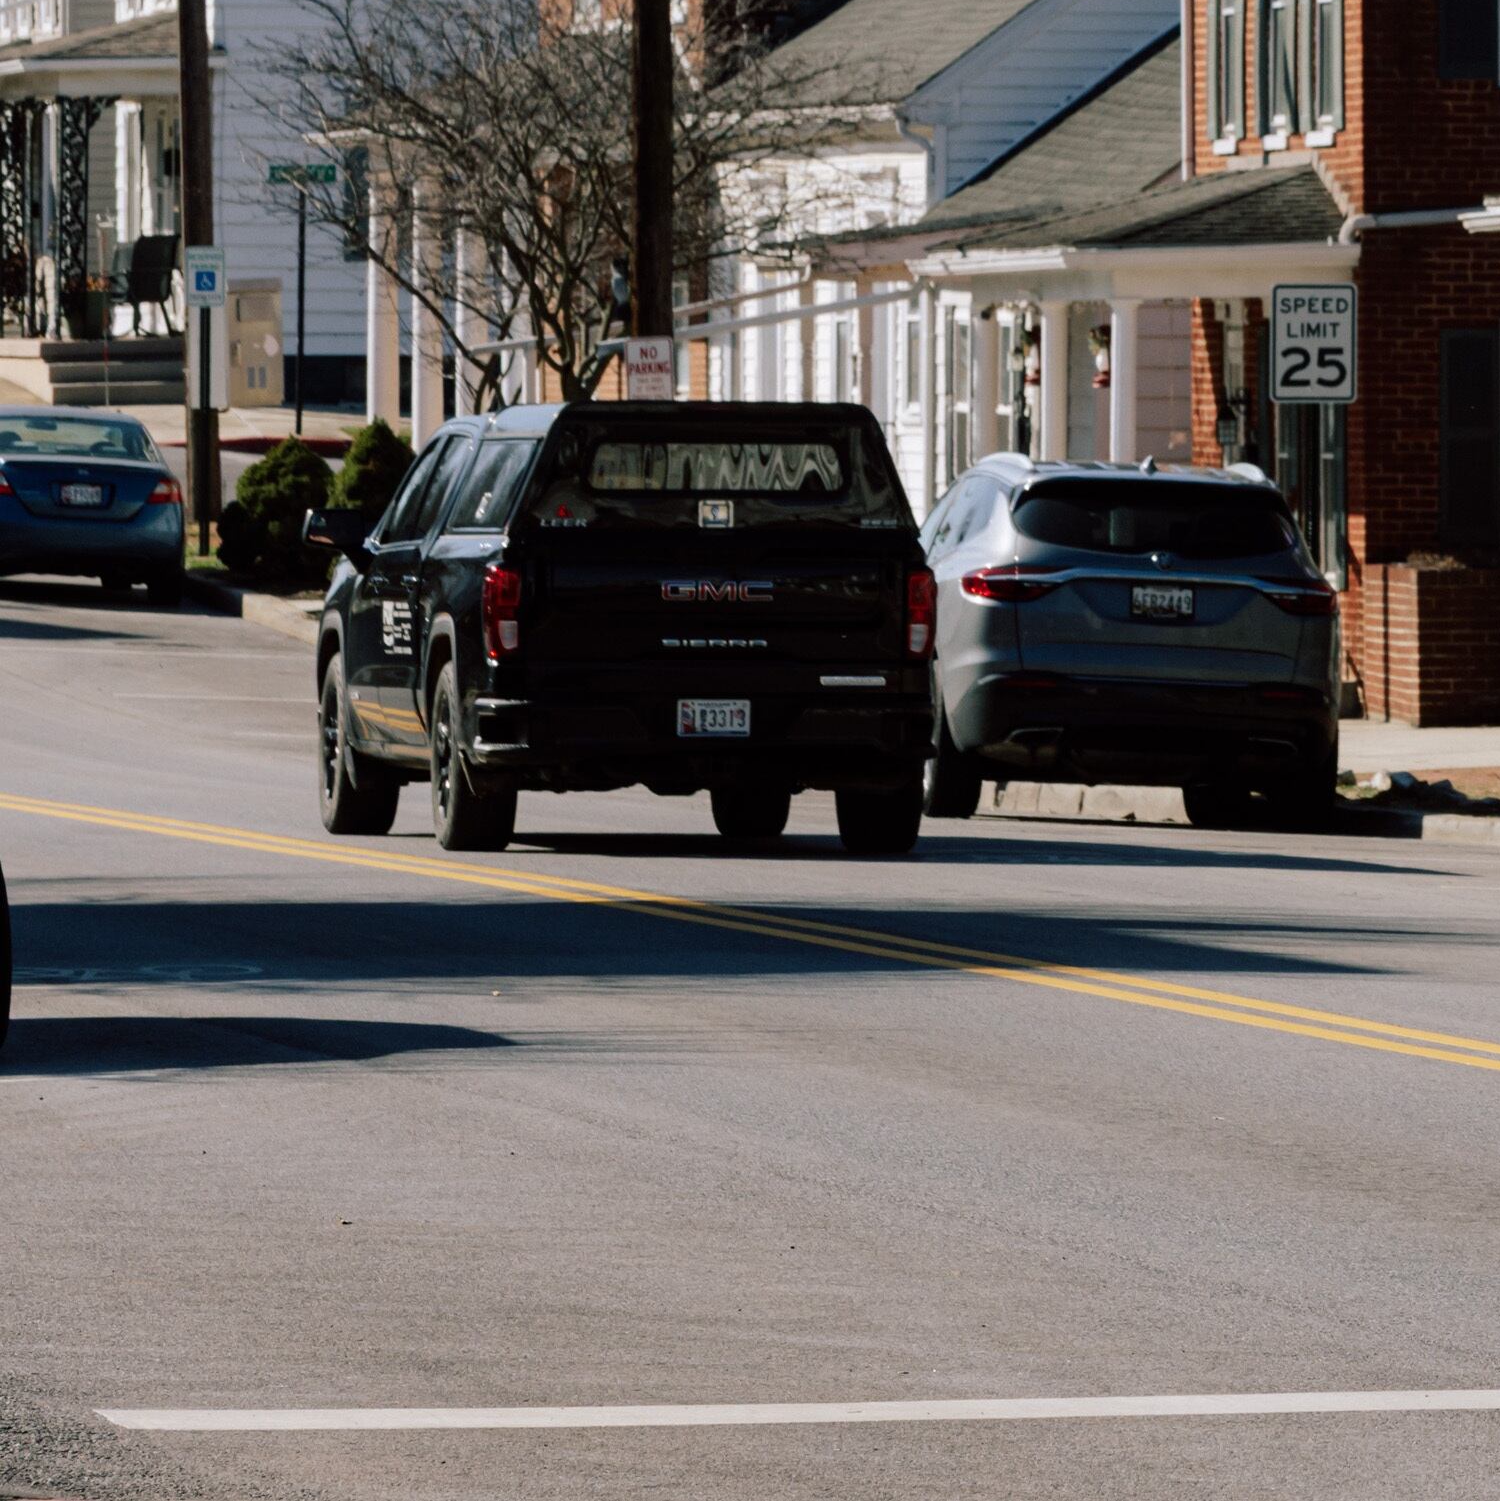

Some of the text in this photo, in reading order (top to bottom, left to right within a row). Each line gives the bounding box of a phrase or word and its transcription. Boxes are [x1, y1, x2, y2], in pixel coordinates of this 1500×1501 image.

[1280, 297, 1349, 314] SPEED
[1287, 322, 1340, 338] LIMIT
[640, 346, 658, 360] NO
[628, 362, 669, 375] PARKING
[1280, 347, 1347, 388] 25
[661, 580, 774, 602] GMC
[661, 638, 768, 648] SIERRA
